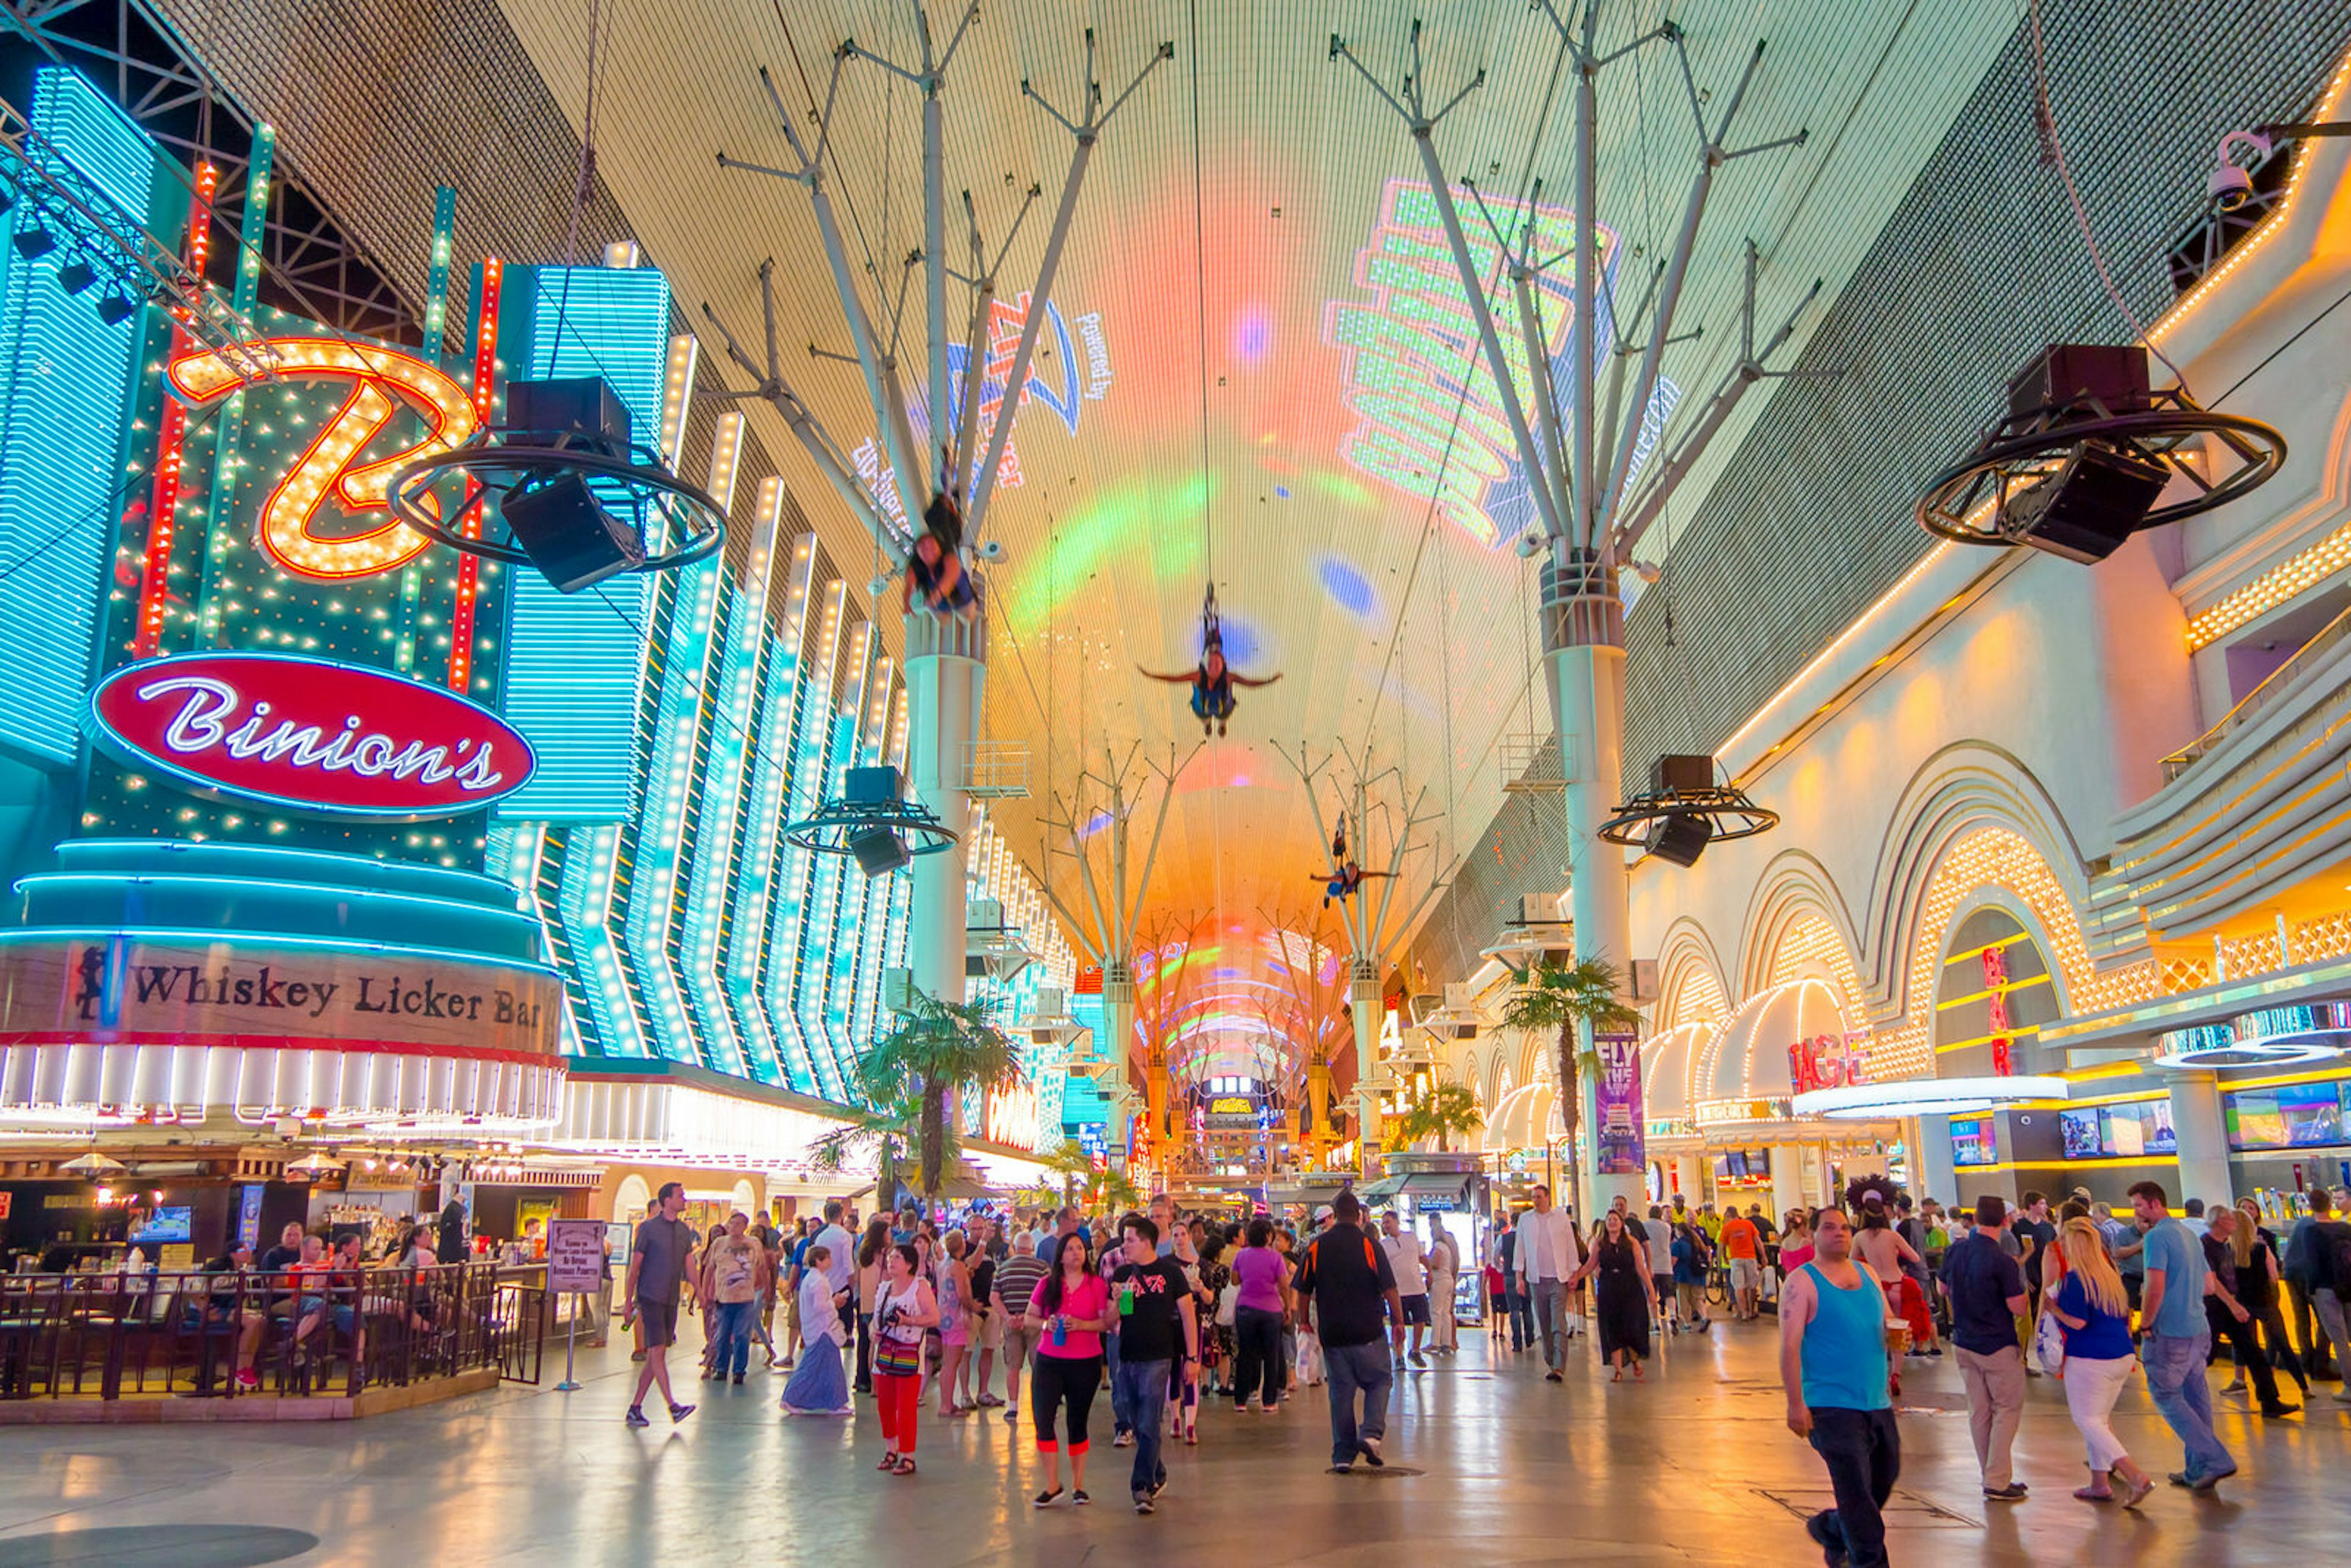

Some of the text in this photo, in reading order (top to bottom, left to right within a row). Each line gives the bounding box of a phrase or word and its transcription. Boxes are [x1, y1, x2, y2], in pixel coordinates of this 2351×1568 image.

[1074, 312, 1113, 400] Powered by
[138, 676, 503, 790] Binion's
[131, 966, 540, 1028] Whiskey Licker Bar
[1594, 1041, 1638, 1068] FLY
[1601, 1068, 1633, 1082] THE
